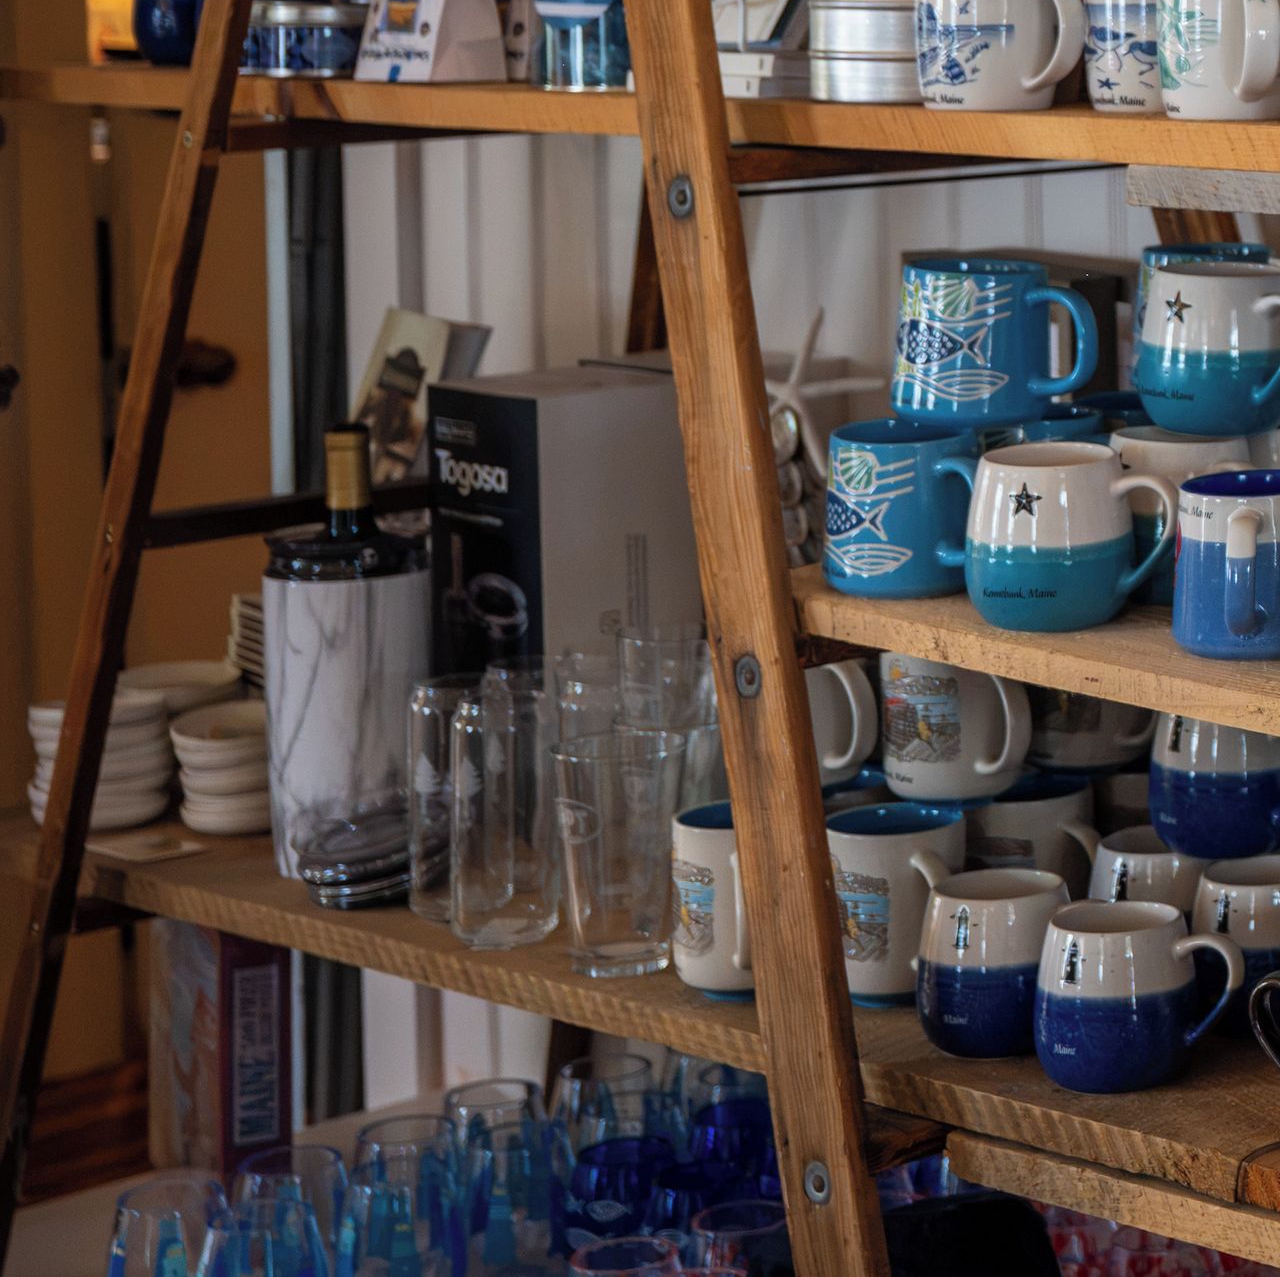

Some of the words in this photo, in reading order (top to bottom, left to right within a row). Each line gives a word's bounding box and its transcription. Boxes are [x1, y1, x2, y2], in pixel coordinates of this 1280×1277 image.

[1119, 93, 1147, 107] Maine
[434, 448, 509, 496] Togosa
[982, 586, 1025, 600] Kennebunk,
[1028, 588, 1057, 600] Maine
[1053, 1043, 1077, 1055] Maine
